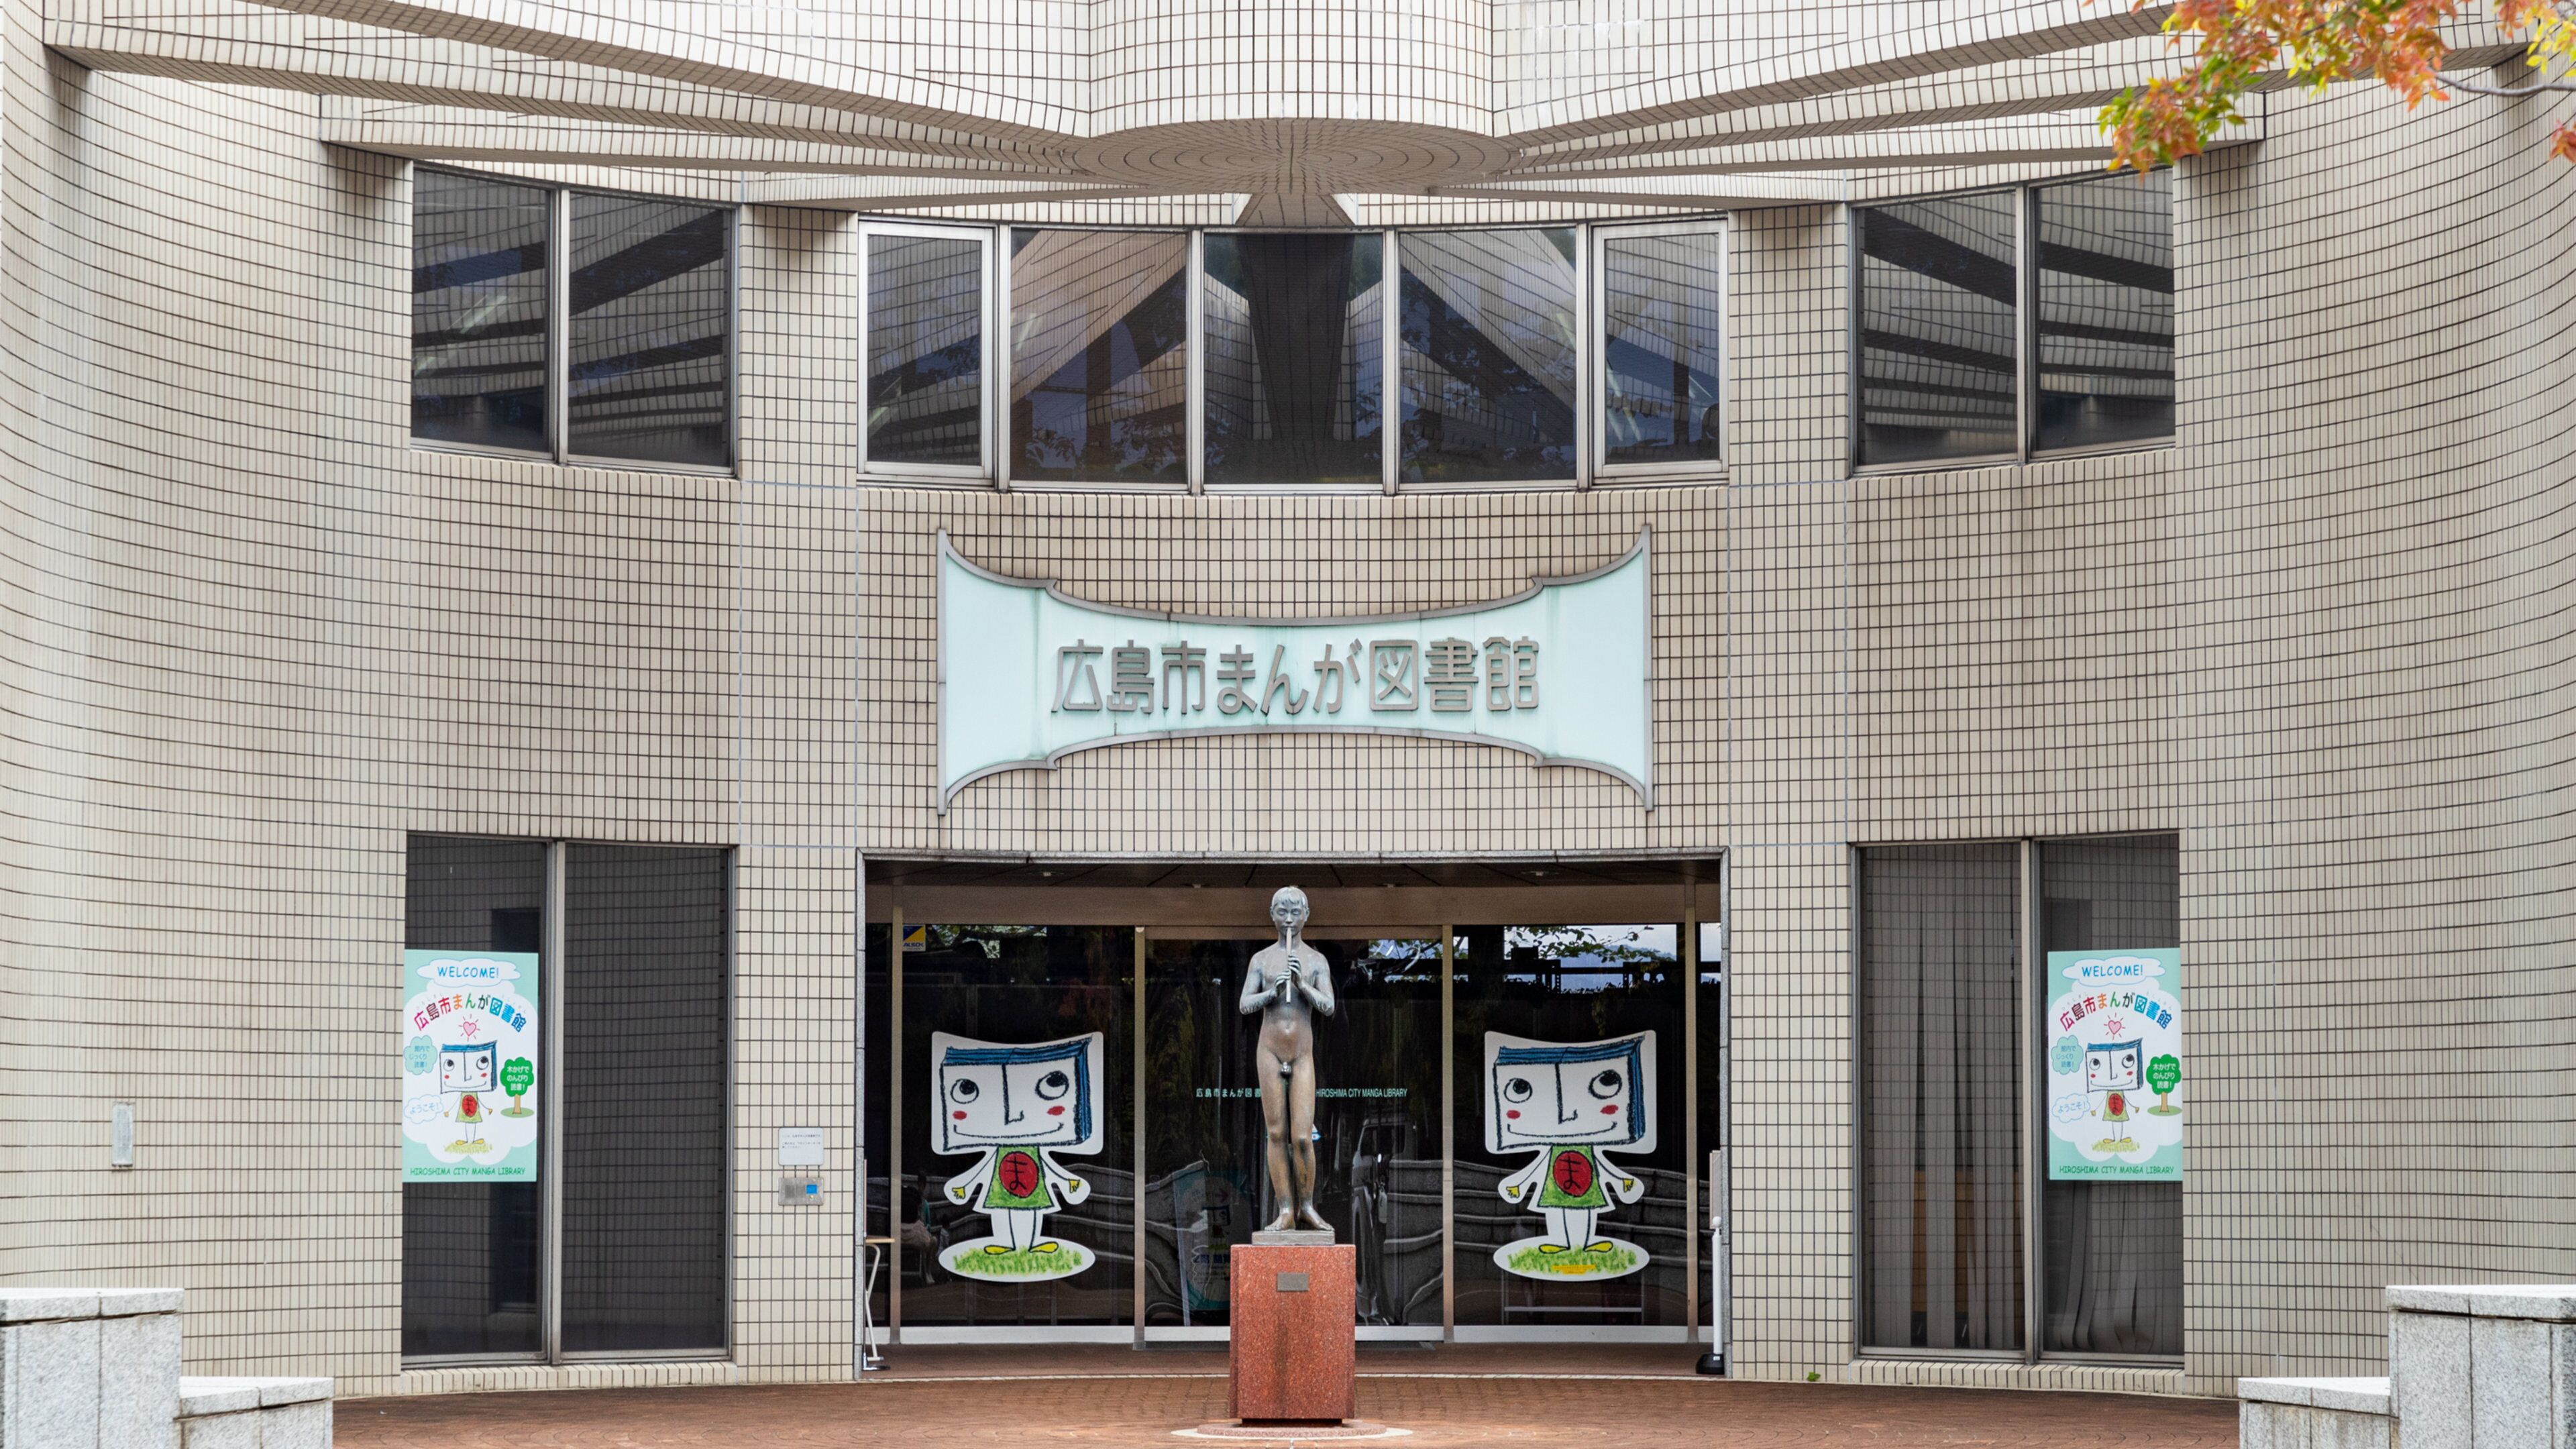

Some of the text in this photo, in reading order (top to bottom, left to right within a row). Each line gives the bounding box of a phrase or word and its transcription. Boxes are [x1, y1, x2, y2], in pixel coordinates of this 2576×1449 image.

[1051, 635, 1539, 715] 広島市まんが図書館
[437, 966, 499, 978] WELCOME!
[2082, 965, 2143, 977] WELCOME!
[414, 993, 527, 1032] 広島市まんが図書館
[2059, 991, 2173, 1031] 広島市まんが図書館
[1316, 1088, 1407, 1097] HIROSHIMA CITY MANGA LIBRARY
[2058, 1101, 2086, 1114] ようこそ!
[410, 1167, 451, 1176] HIROSHIMA
[453, 1167, 470, 1175] CITY
[472, 1167, 496, 1175] MANGA
[1006, 1156, 1028, 1190] ま
[1560, 1155, 1582, 1189] ま
[2059, 1166, 2174, 1174] HIROSHIMA CITY MANGA LIBRARY
